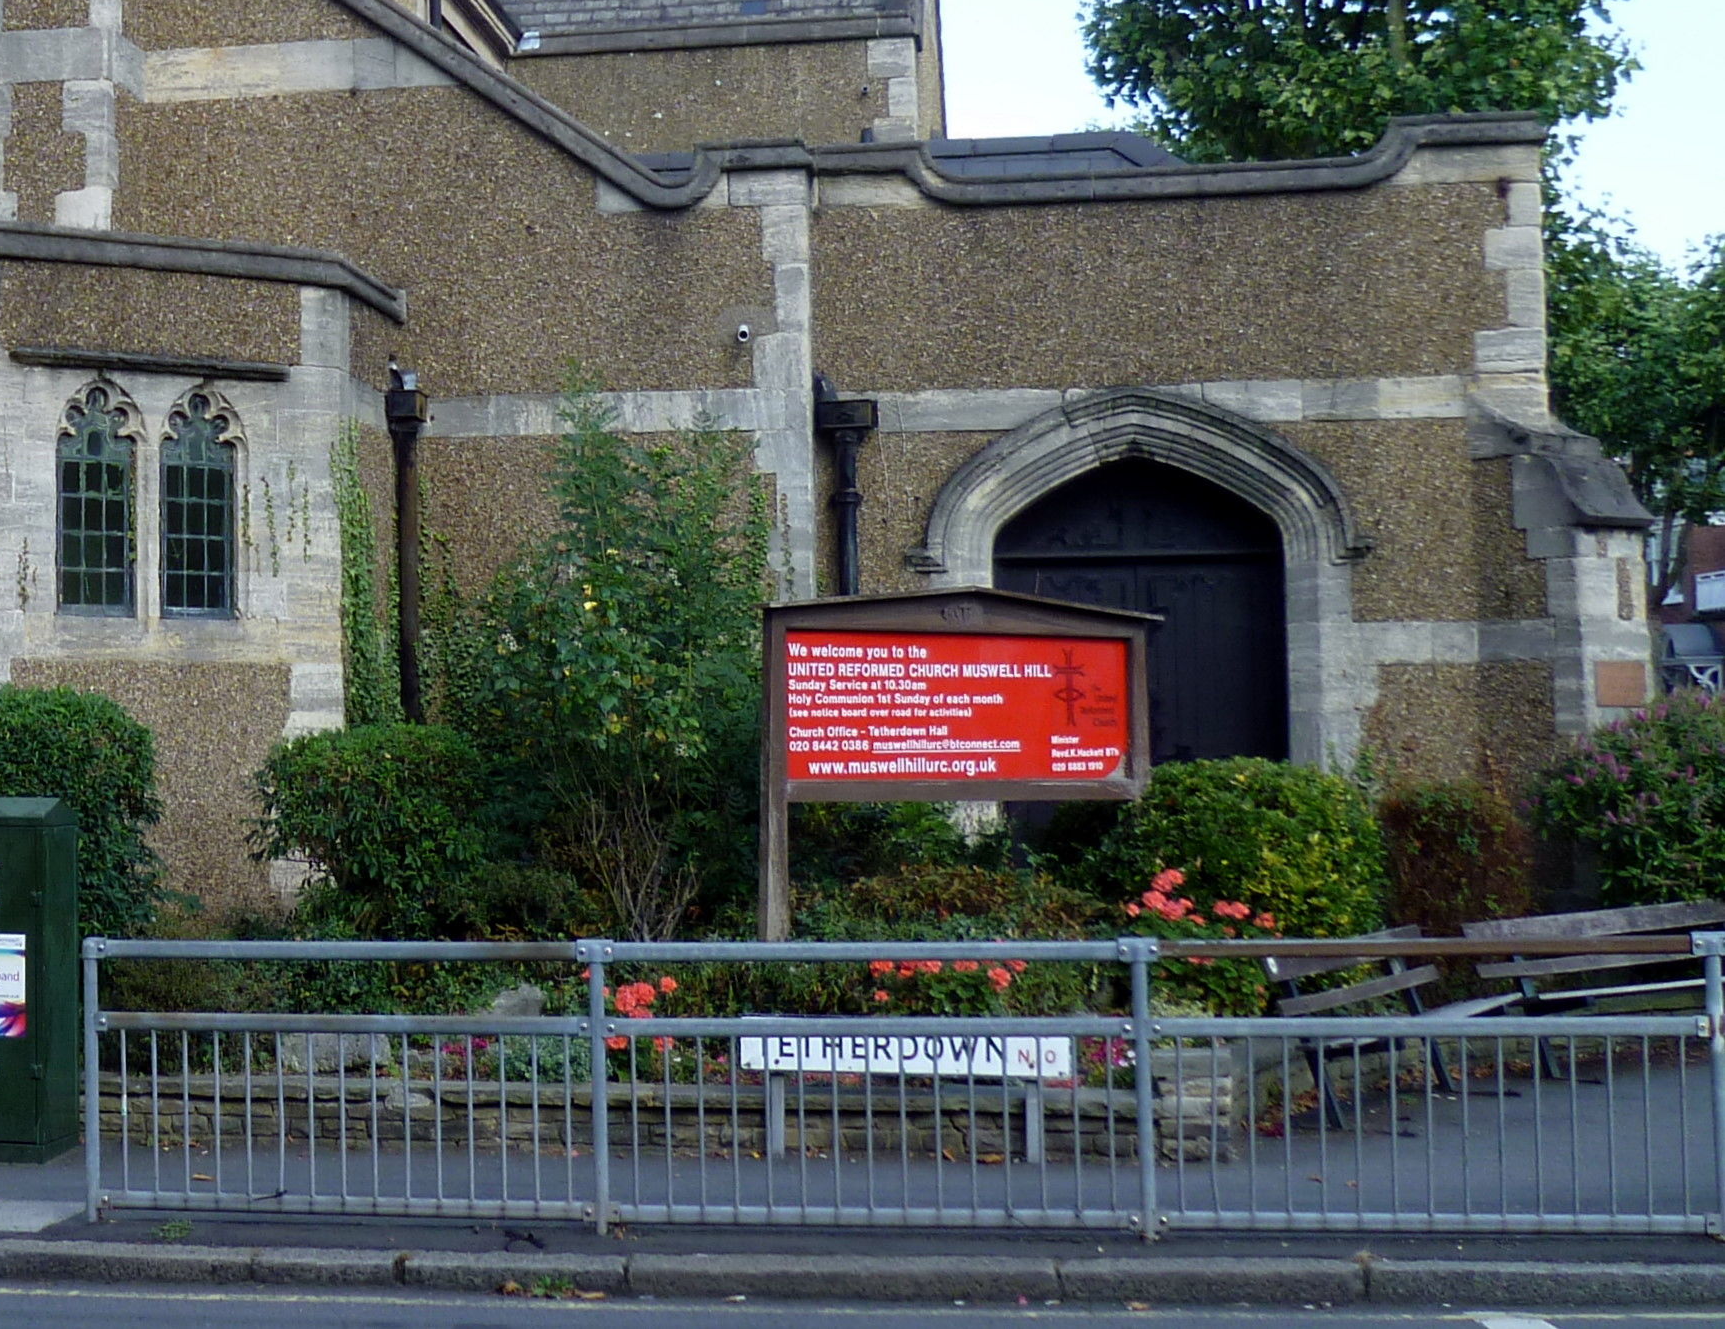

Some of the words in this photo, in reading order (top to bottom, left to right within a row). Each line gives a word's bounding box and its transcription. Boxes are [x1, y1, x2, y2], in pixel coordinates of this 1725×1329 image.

[788, 643, 807, 657] We
[812, 644, 863, 657] welcome
[867, 647, 888, 660] you
[892, 645, 904, 658] to
[908, 645, 927, 659] the
[788, 663, 835, 676] UNITED
[838, 663, 905, 677] REFORMED
[909, 664, 959, 677] CHURCH
[962, 664, 1022, 677] MUSWELL
[1024, 664, 1052, 677] HILL
[788, 679, 826, 692] Sunday
[829, 680, 868, 690] Service
[871, 680, 881, 690] at
[884, 680, 927, 690] 10.30am
[788, 693, 812, 705] Holy
[815, 693, 874, 704] Communion
[877, 693, 891, 704] 1st
[894, 693, 930, 706] Sunday
[933, 694, 944, 704] of
[946, 694, 970, 704] each
[973, 694, 1004, 704] month
[788, 707, 808, 718] (see
[811, 707, 839, 717] notice
[841, 707, 867, 717] board
[869, 709, 889, 718] over
[892, 707, 912, 717] road
[914, 707, 928, 717] for
[929, 706, 972, 718] activities)
[789, 726, 824, 738] Church
[827, 726, 858, 737] Office
[868, 726, 926, 737] Tetherdown
[929, 726, 948, 736] Hall
[789, 741, 809, 752] 020
[812, 740, 839, 751] 8442
[808, 758, 997, 775] www.muswellhillurc.org.uk
